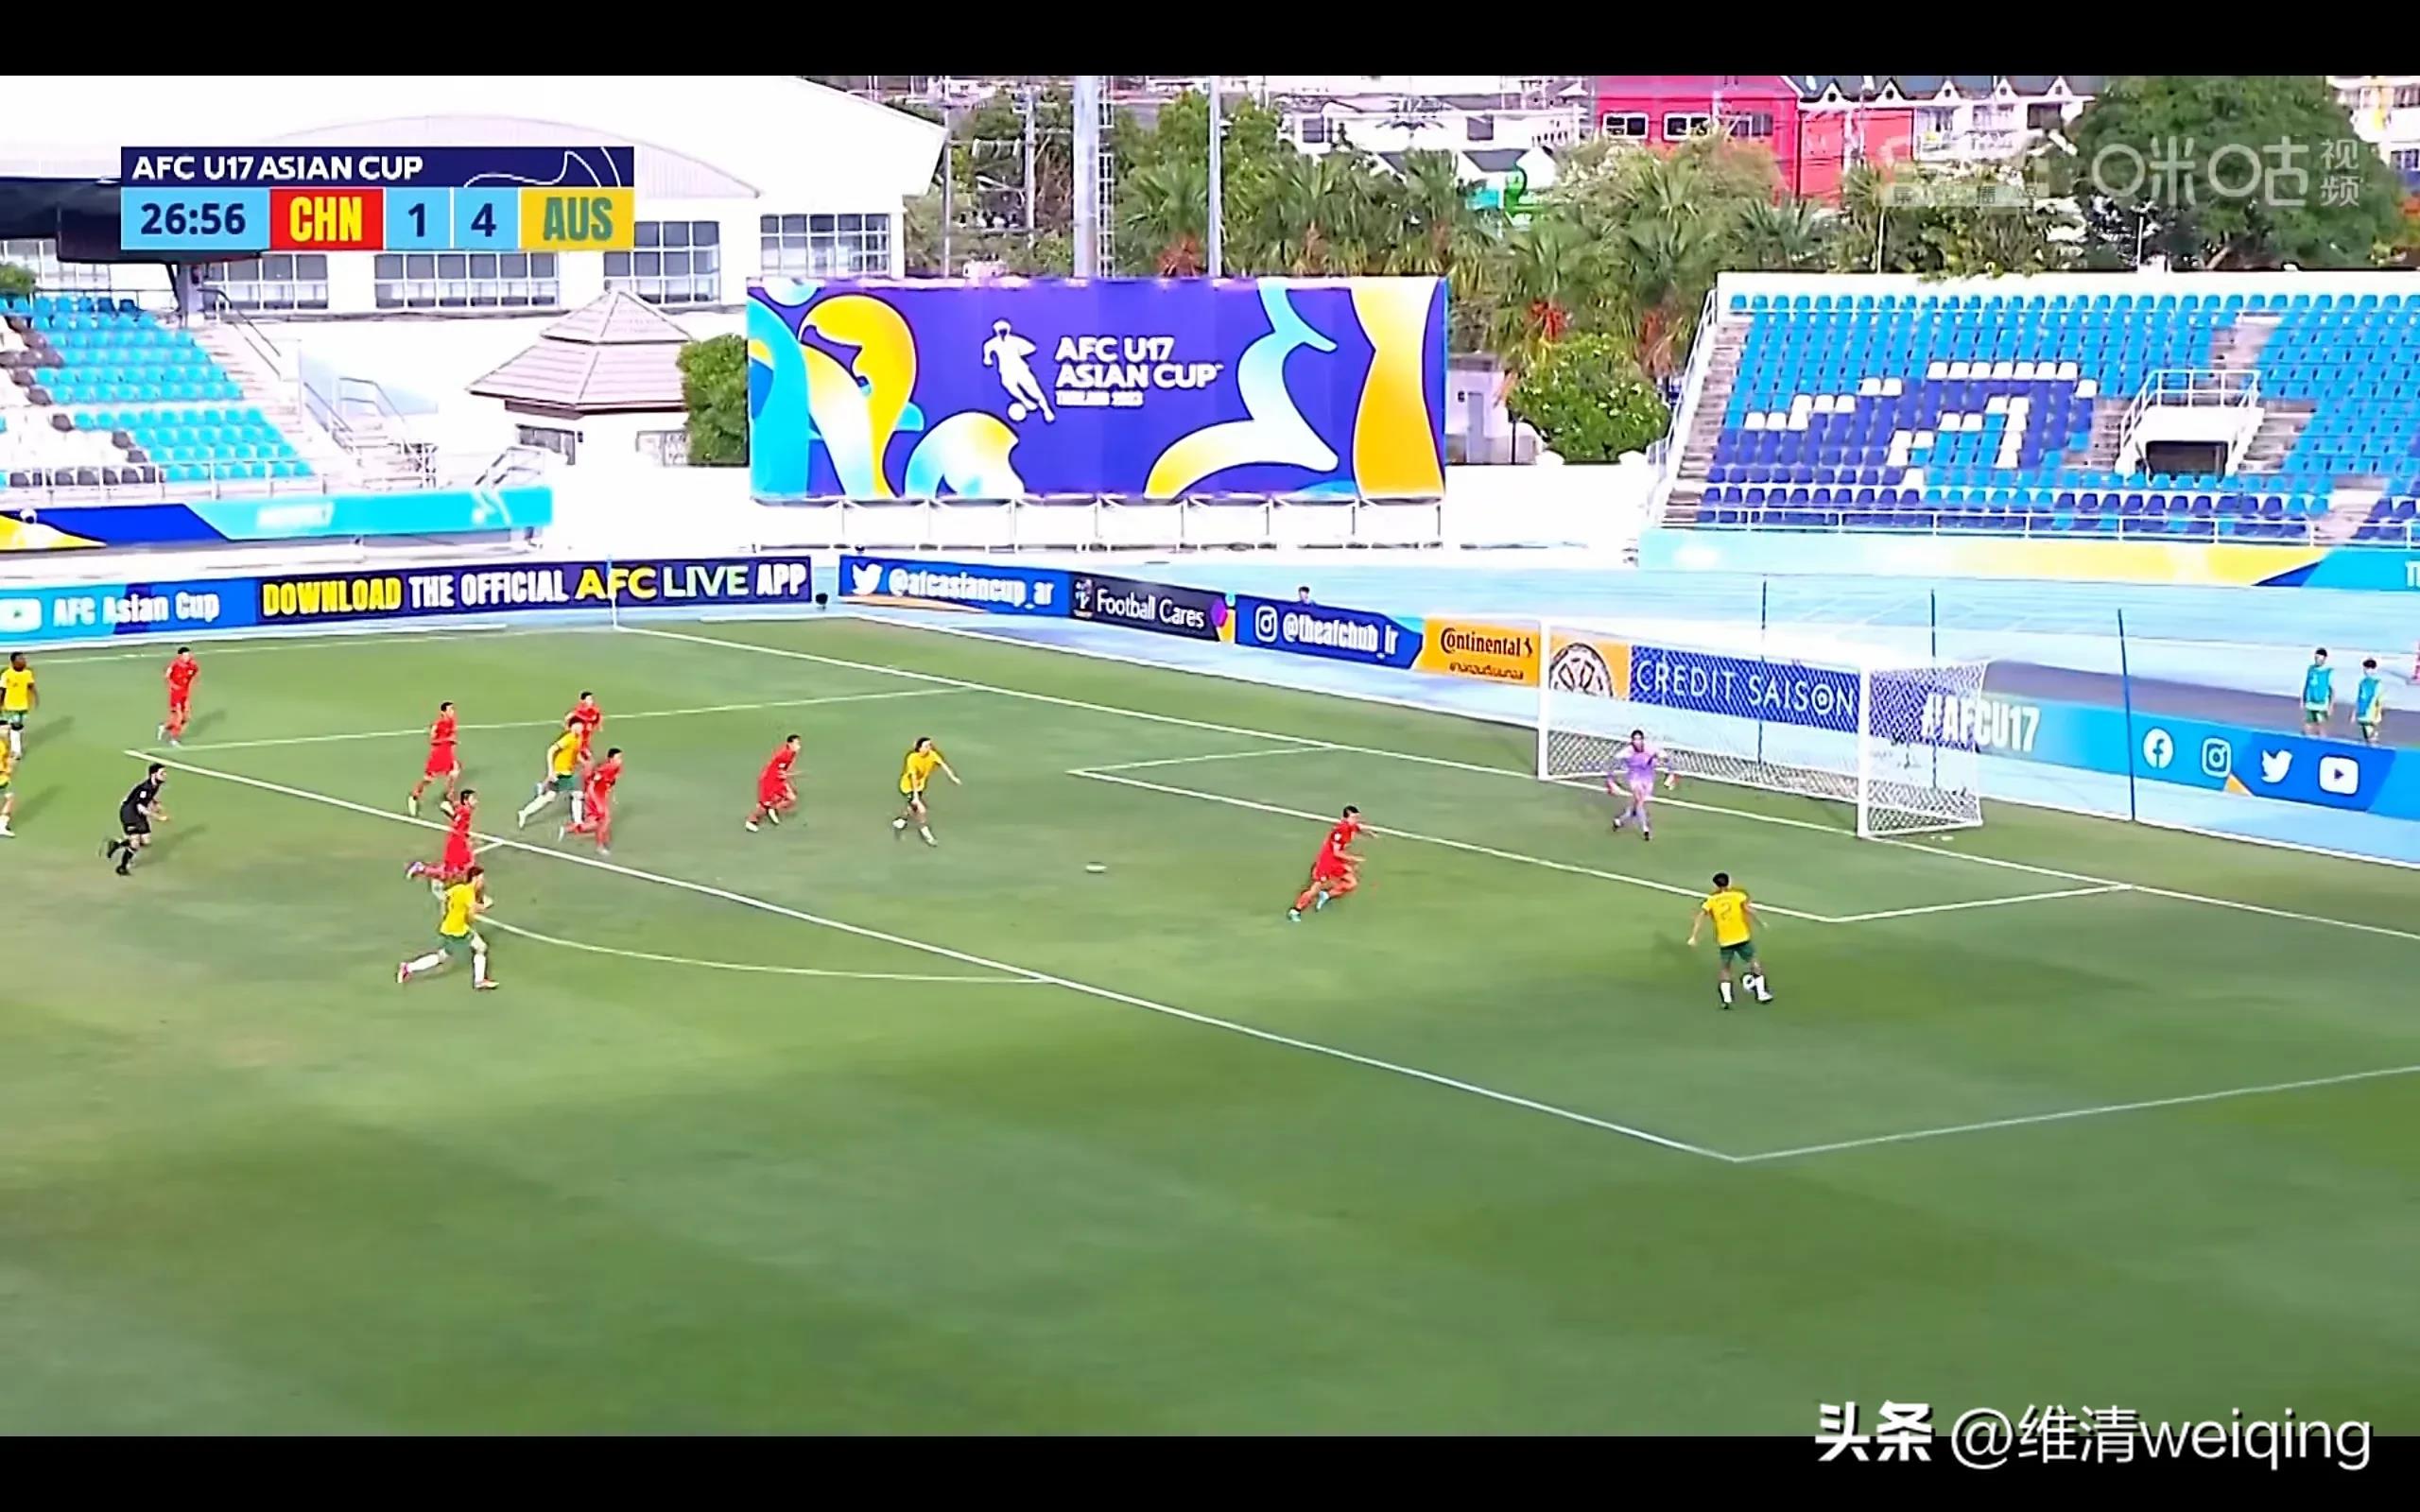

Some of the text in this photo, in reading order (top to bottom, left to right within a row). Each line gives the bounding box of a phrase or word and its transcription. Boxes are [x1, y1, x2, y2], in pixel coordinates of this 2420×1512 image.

[1055, 336, 1175, 362] AFC U17
[1055, 363, 1217, 388] ASIAN CUP
[263, 563, 806, 616] DOWNLOAD THE OFFICIAL AFC LIVE APP
[1097, 588, 1205, 628] Football Cares
[53, 592, 219, 627] AFC Asian Cup
[1440, 627, 1521, 657] Continental
[1636, 660, 1854, 716] CREDIT SAISON
[1920, 693, 2041, 753] #AFCU17
